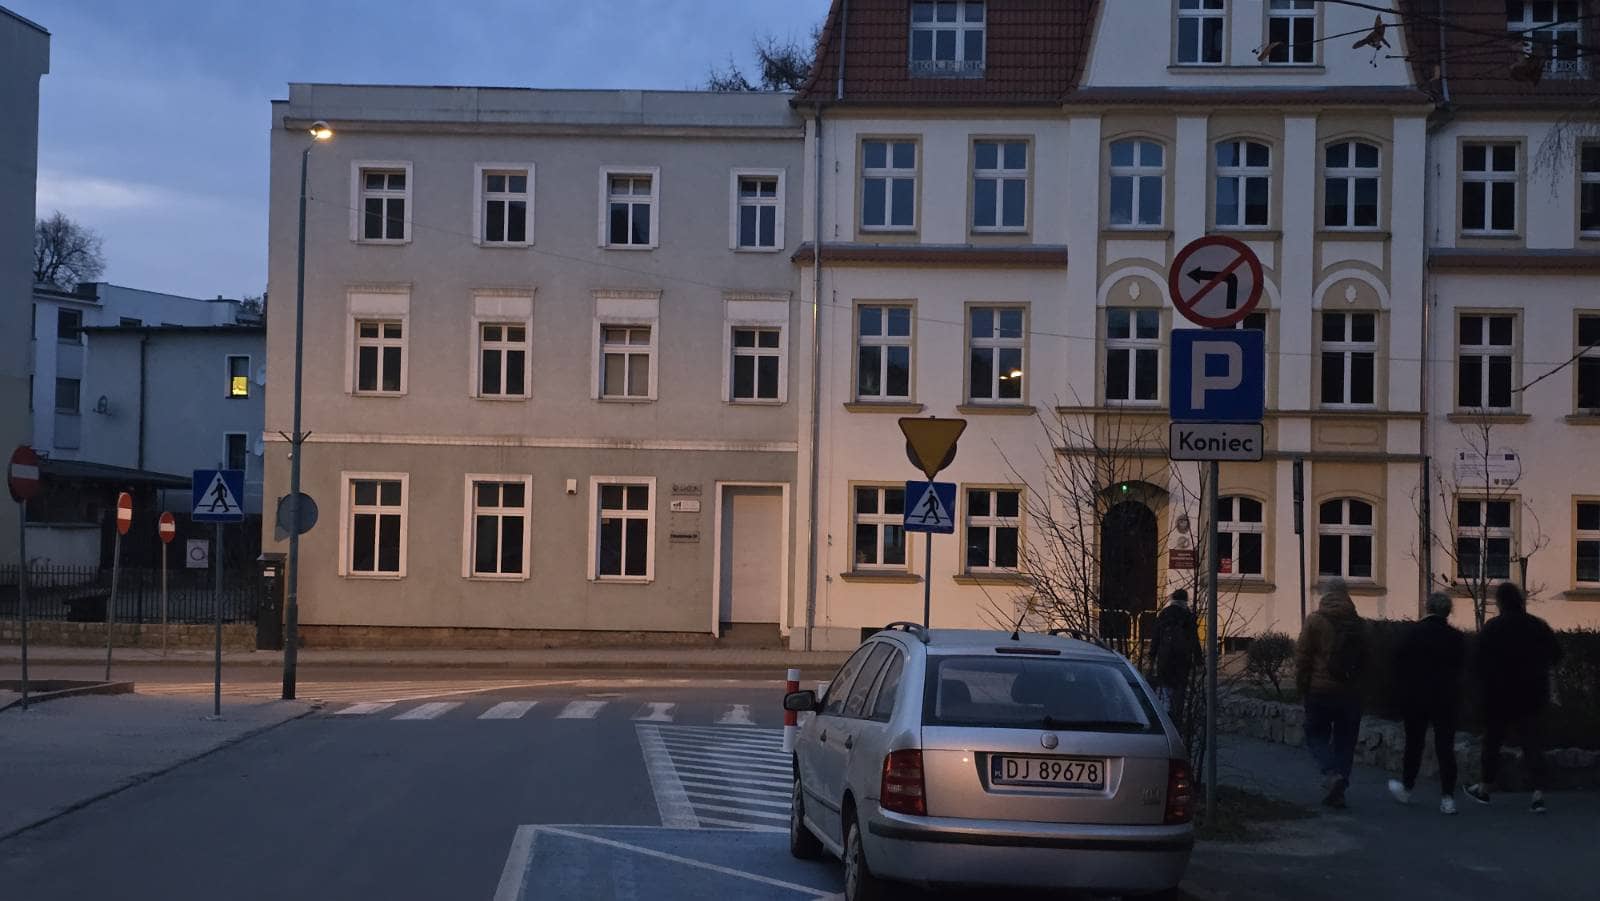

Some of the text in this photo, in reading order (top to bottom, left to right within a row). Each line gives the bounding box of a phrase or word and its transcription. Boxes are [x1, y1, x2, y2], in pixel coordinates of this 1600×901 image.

[1191, 341, 1243, 410] P
[1180, 432, 1253, 452] Koniec
[1007, 760, 1098, 782] DJ 89678
